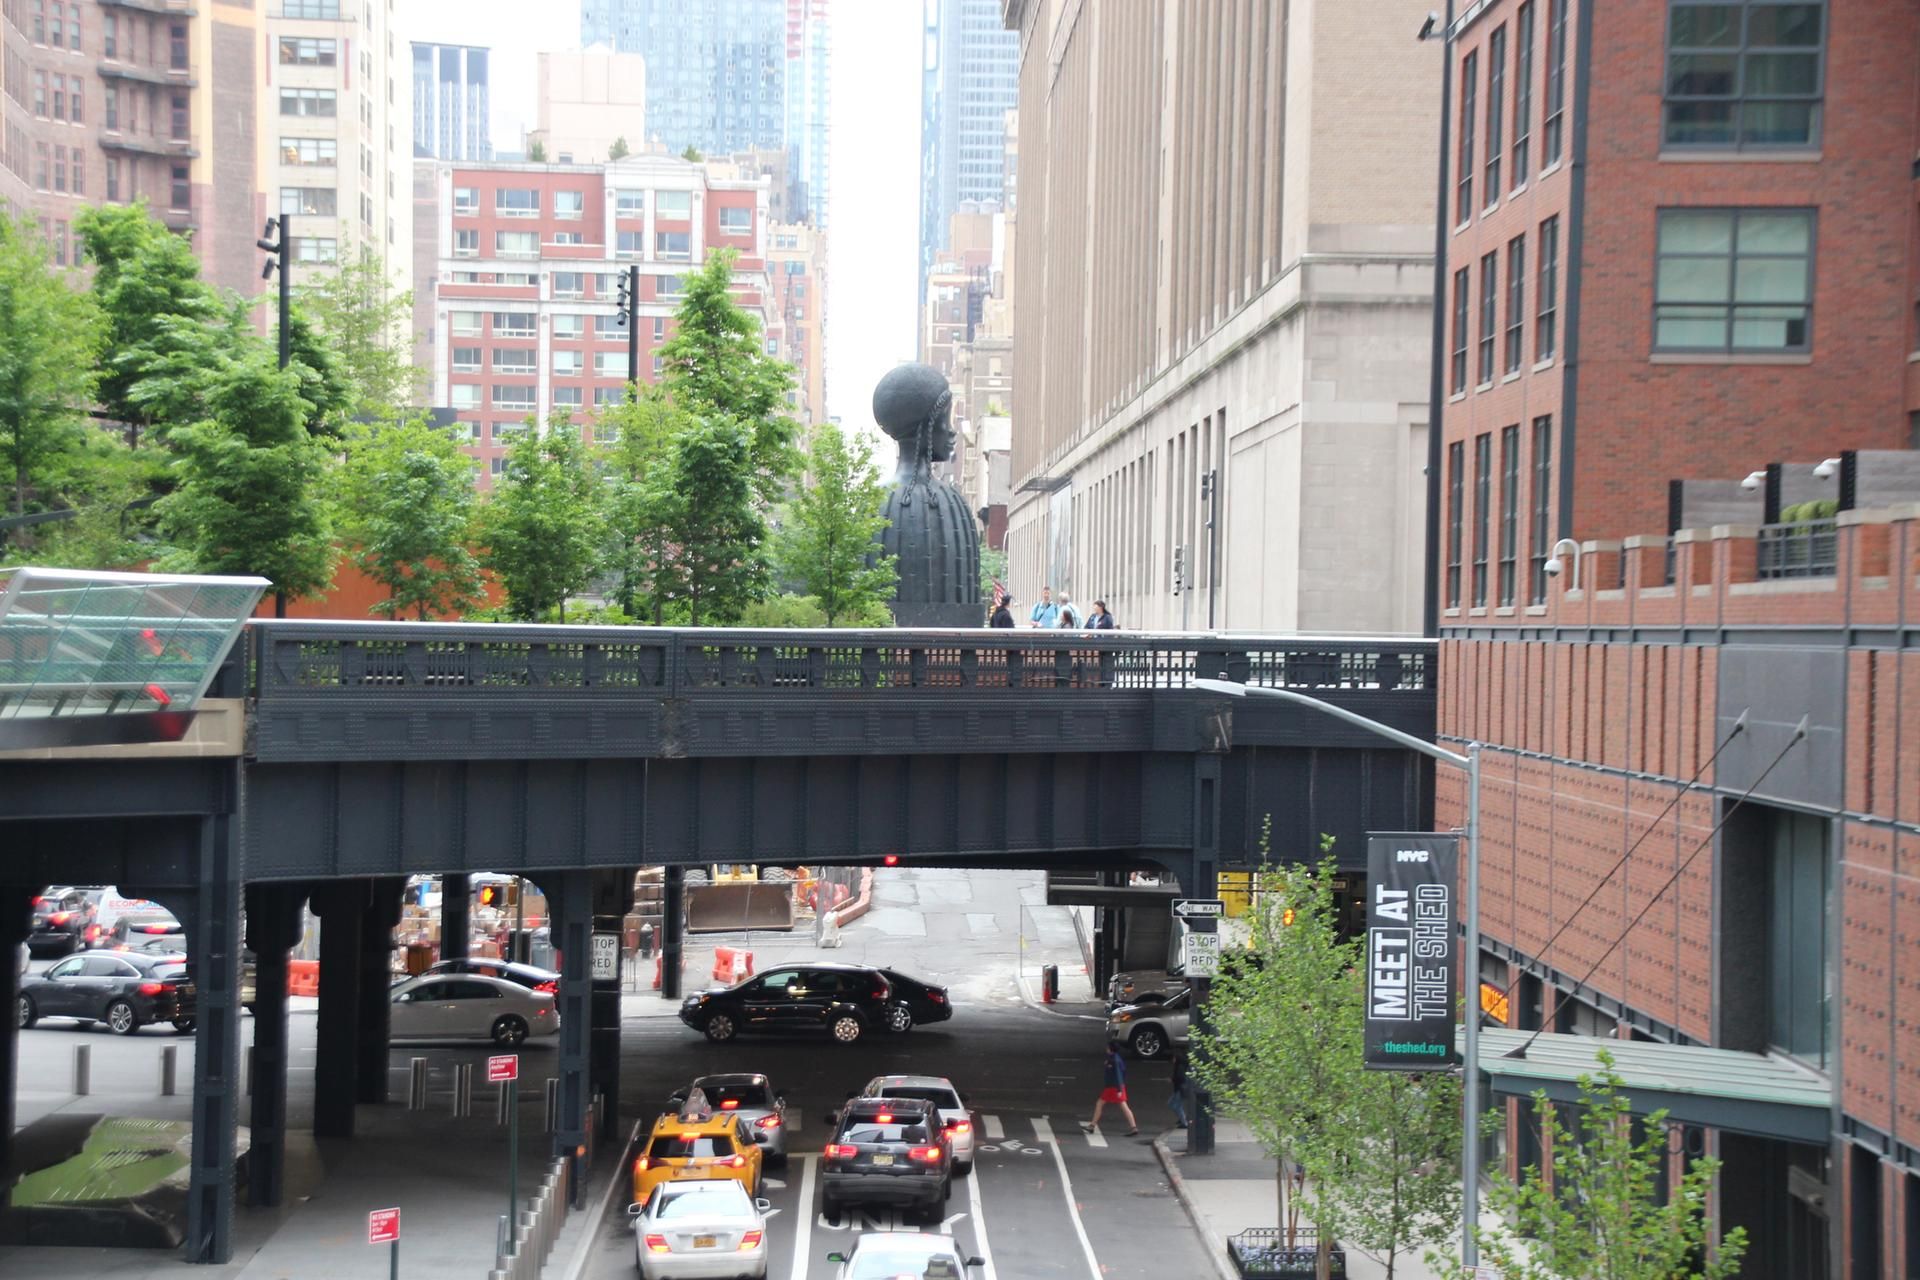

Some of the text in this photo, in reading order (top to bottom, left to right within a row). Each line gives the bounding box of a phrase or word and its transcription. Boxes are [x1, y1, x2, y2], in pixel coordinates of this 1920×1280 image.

[1396, 850, 1429, 862] NYC
[1180, 904, 1195, 912] ONE
[592, 938, 615, 949] TOP
[1373, 884, 1408, 1015] MEET AT
[1413, 883, 1449, 1021] THE SHED
[591, 958, 612, 968] RED
[1191, 955, 1214, 966] RED
[1384, 1041, 1446, 1057] theshed.org
